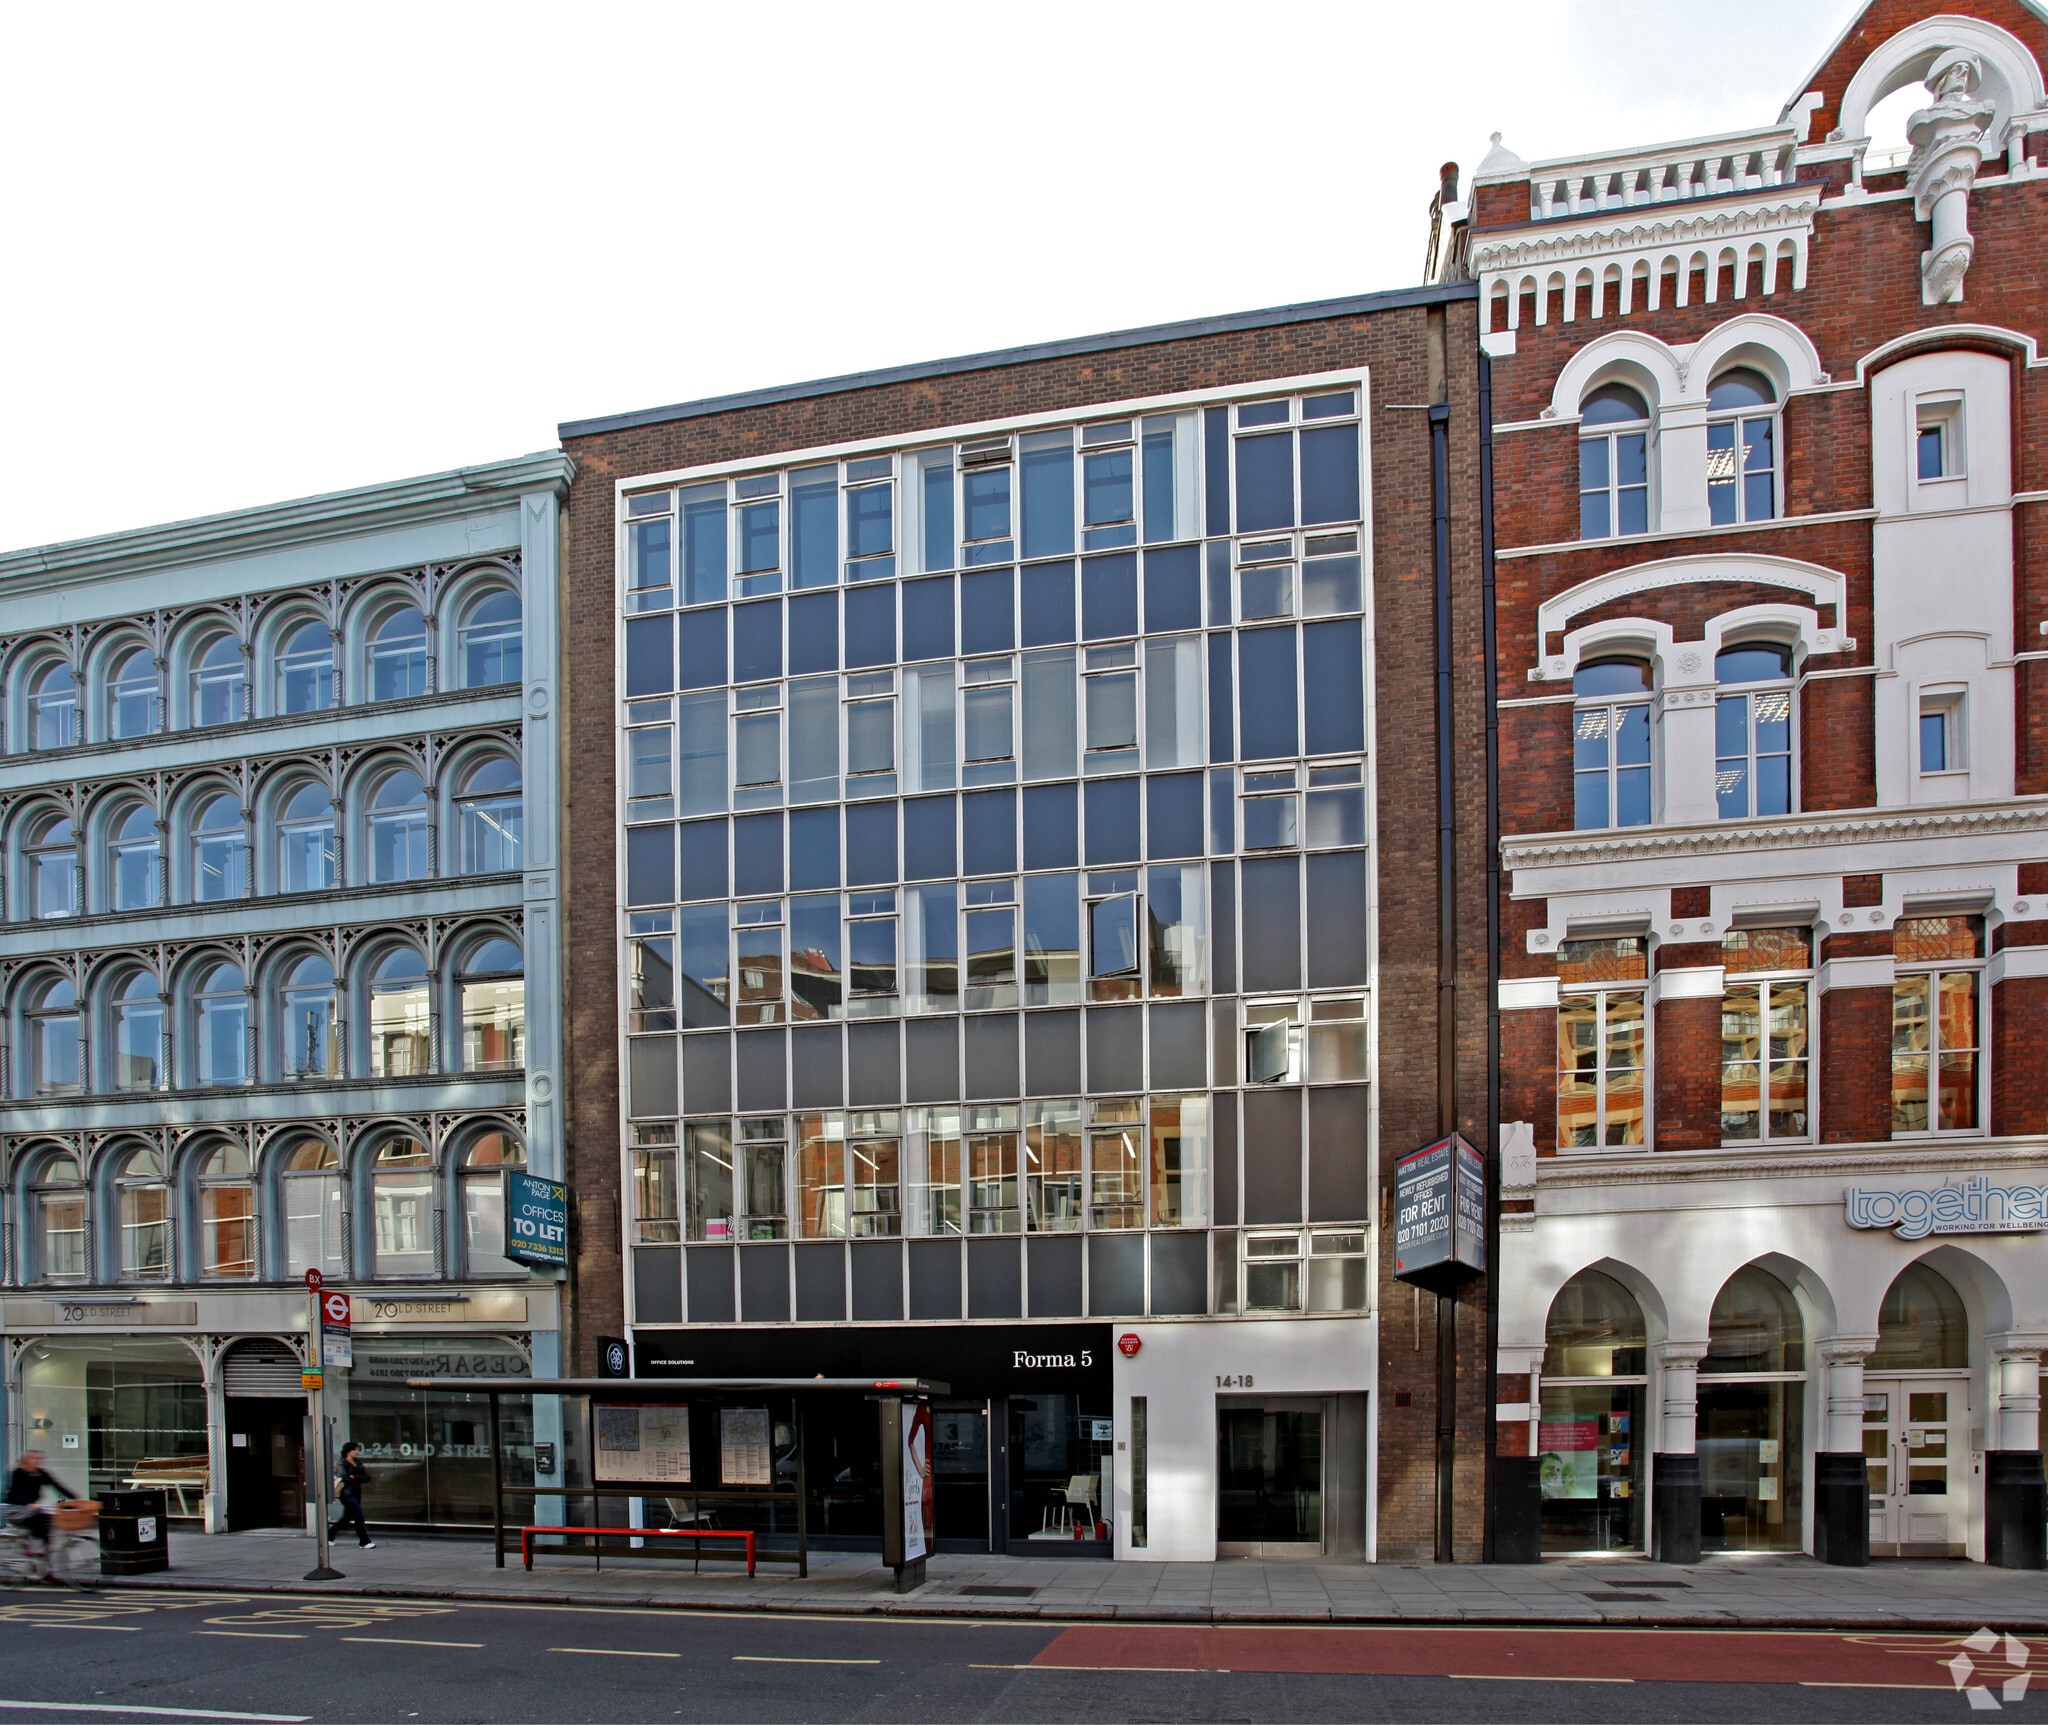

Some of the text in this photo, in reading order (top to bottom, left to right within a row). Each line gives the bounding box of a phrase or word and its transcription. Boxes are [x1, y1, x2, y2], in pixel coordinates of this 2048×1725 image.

[1418, 1156, 1430, 1168] REAL
[1432, 1147, 1449, 1162] ESTATE
[523, 1179, 550, 1191] ANTON
[1416, 1172, 1448, 1192] REFURBISHED
[532, 1190, 550, 1200] PAGE
[1414, 1188, 1433, 1202] OFFICES
[522, 1204, 564, 1223] OFFICES
[1401, 1194, 1446, 1225] FOR RENT
[514, 1218, 564, 1242] TO LET
[1398, 1215, 1449, 1244] 020 7101 2020
[512, 1239, 564, 1256] 020 7336 1313
[520, 1249, 564, 1262] antonpage.com
[309, 1275, 320, 1284] BX
[64, 1307, 84, 1321] 20
[100, 1308, 131, 1317] STREET
[375, 1303, 398, 1318] 20
[416, 1304, 452, 1313] STREET
[1013, 1350, 1092, 1368] Forma 5
[1216, 1375, 1253, 1388] 14-18
[357, 1443, 514, 1458] 0-24 OLD STRET
